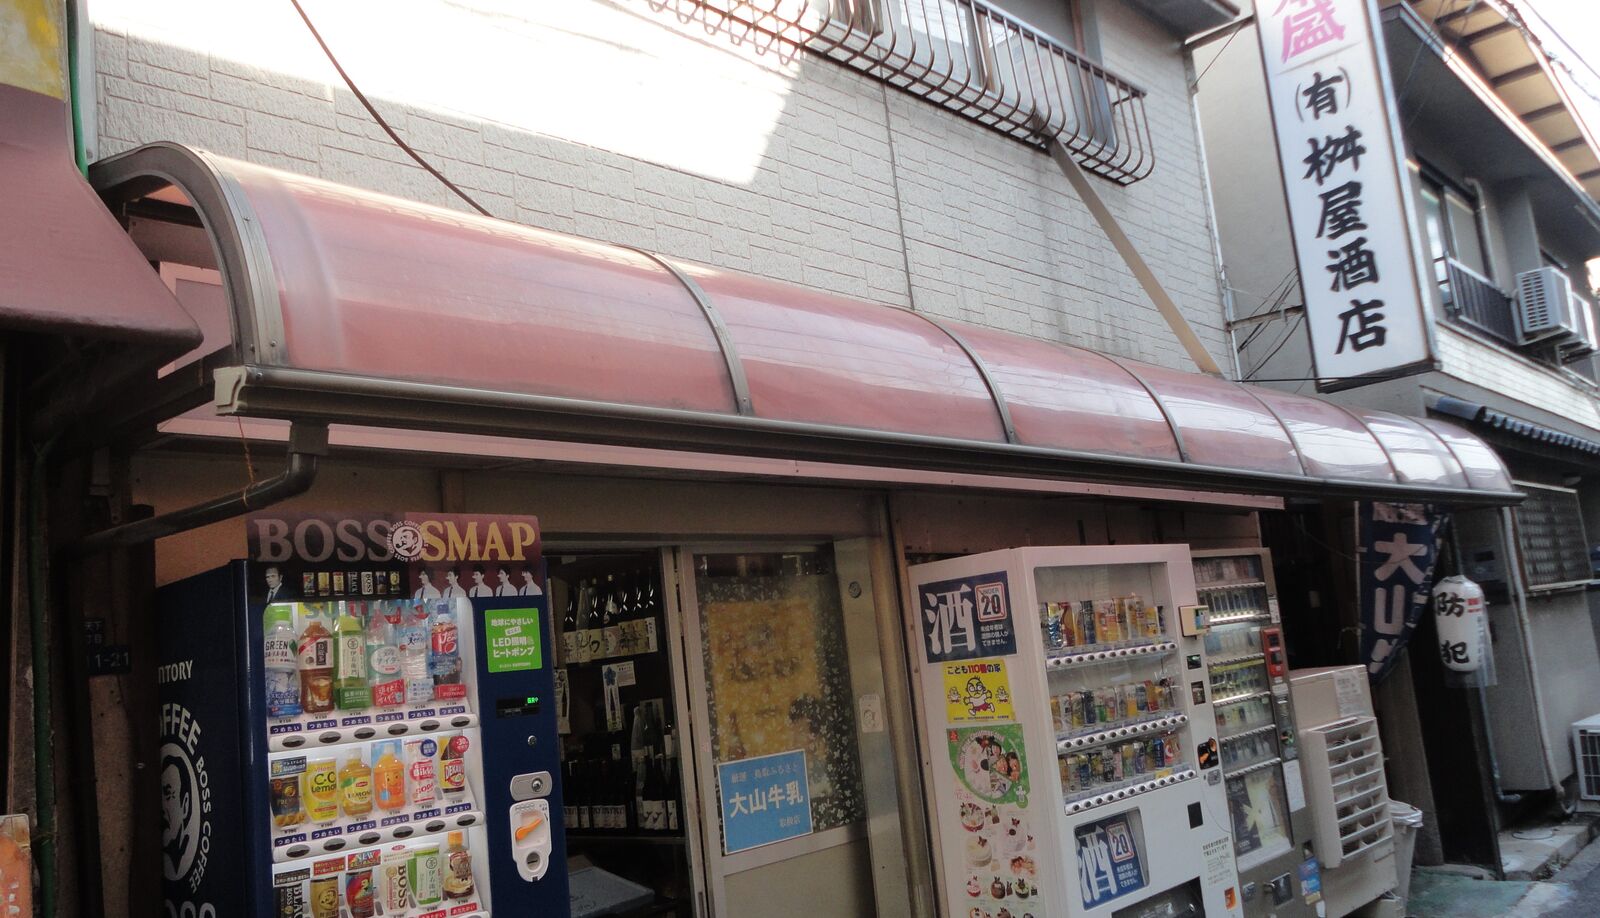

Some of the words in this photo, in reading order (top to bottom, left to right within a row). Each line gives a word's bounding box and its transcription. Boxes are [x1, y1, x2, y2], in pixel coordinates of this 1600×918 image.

[253, 519, 394, 562] BOSS
[421, 520, 536, 562] SMAP
[981, 594, 1001, 615] 20
[925, 583, 976, 655] 酒
[1436, 592, 1470, 664] 防犯
[265, 641, 288, 651] GREEN
[493, 647, 535, 658] ヒートポンプ
[160, 703, 201, 755] FFEE
[345, 717, 369, 725] つめたい
[195, 755, 211, 814] BOSS
[447, 804, 469, 813] つめたい
[729, 780, 804, 818] 大山牛乳
[383, 816, 407, 825] つめたい
[416, 810, 440, 818] つめたい
[314, 829, 340, 838] つめたい
[350, 822, 375, 831] つめたい
[277, 835, 304, 845] つめたい
[1113, 834, 1128, 856] 20
[188, 820, 211, 894] COFFEE
[357, 851, 375, 861] NEW
[398, 865, 407, 909] BOSS
